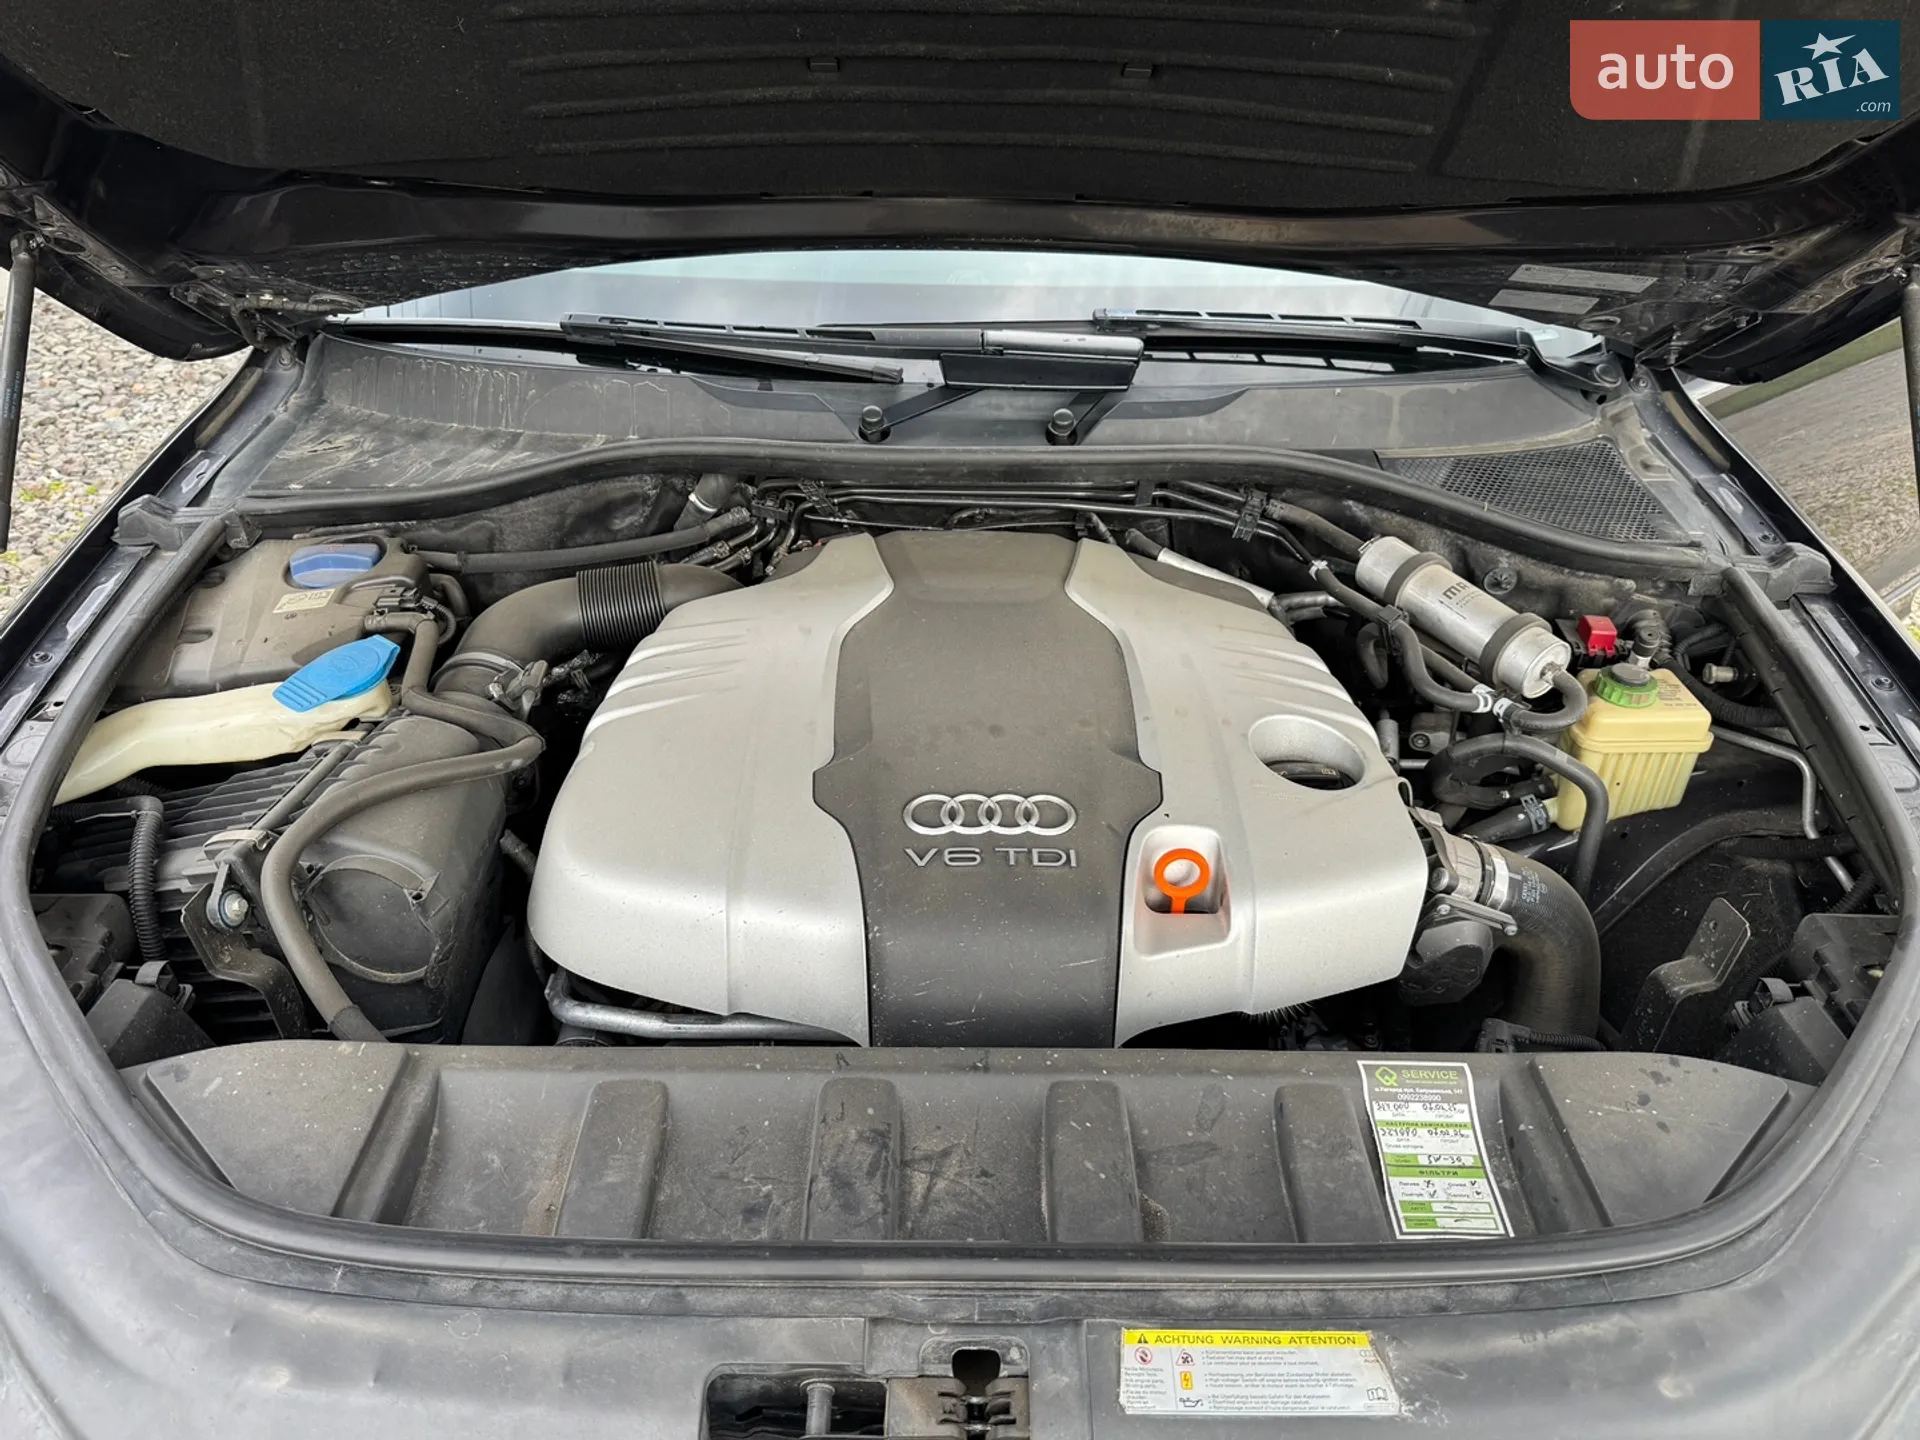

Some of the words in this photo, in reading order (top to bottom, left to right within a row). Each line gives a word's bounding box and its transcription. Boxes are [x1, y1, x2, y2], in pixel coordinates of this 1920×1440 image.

[904, 847, 982, 867] V6
[995, 847, 1078, 868] TDI
[1402, 1069, 1459, 1080] SERVICE
[1154, 1335, 1214, 1344] ACHTUNG
[1221, 1336, 1281, 1345] WARNING
[1288, 1336, 1356, 1345] ATTENTION
